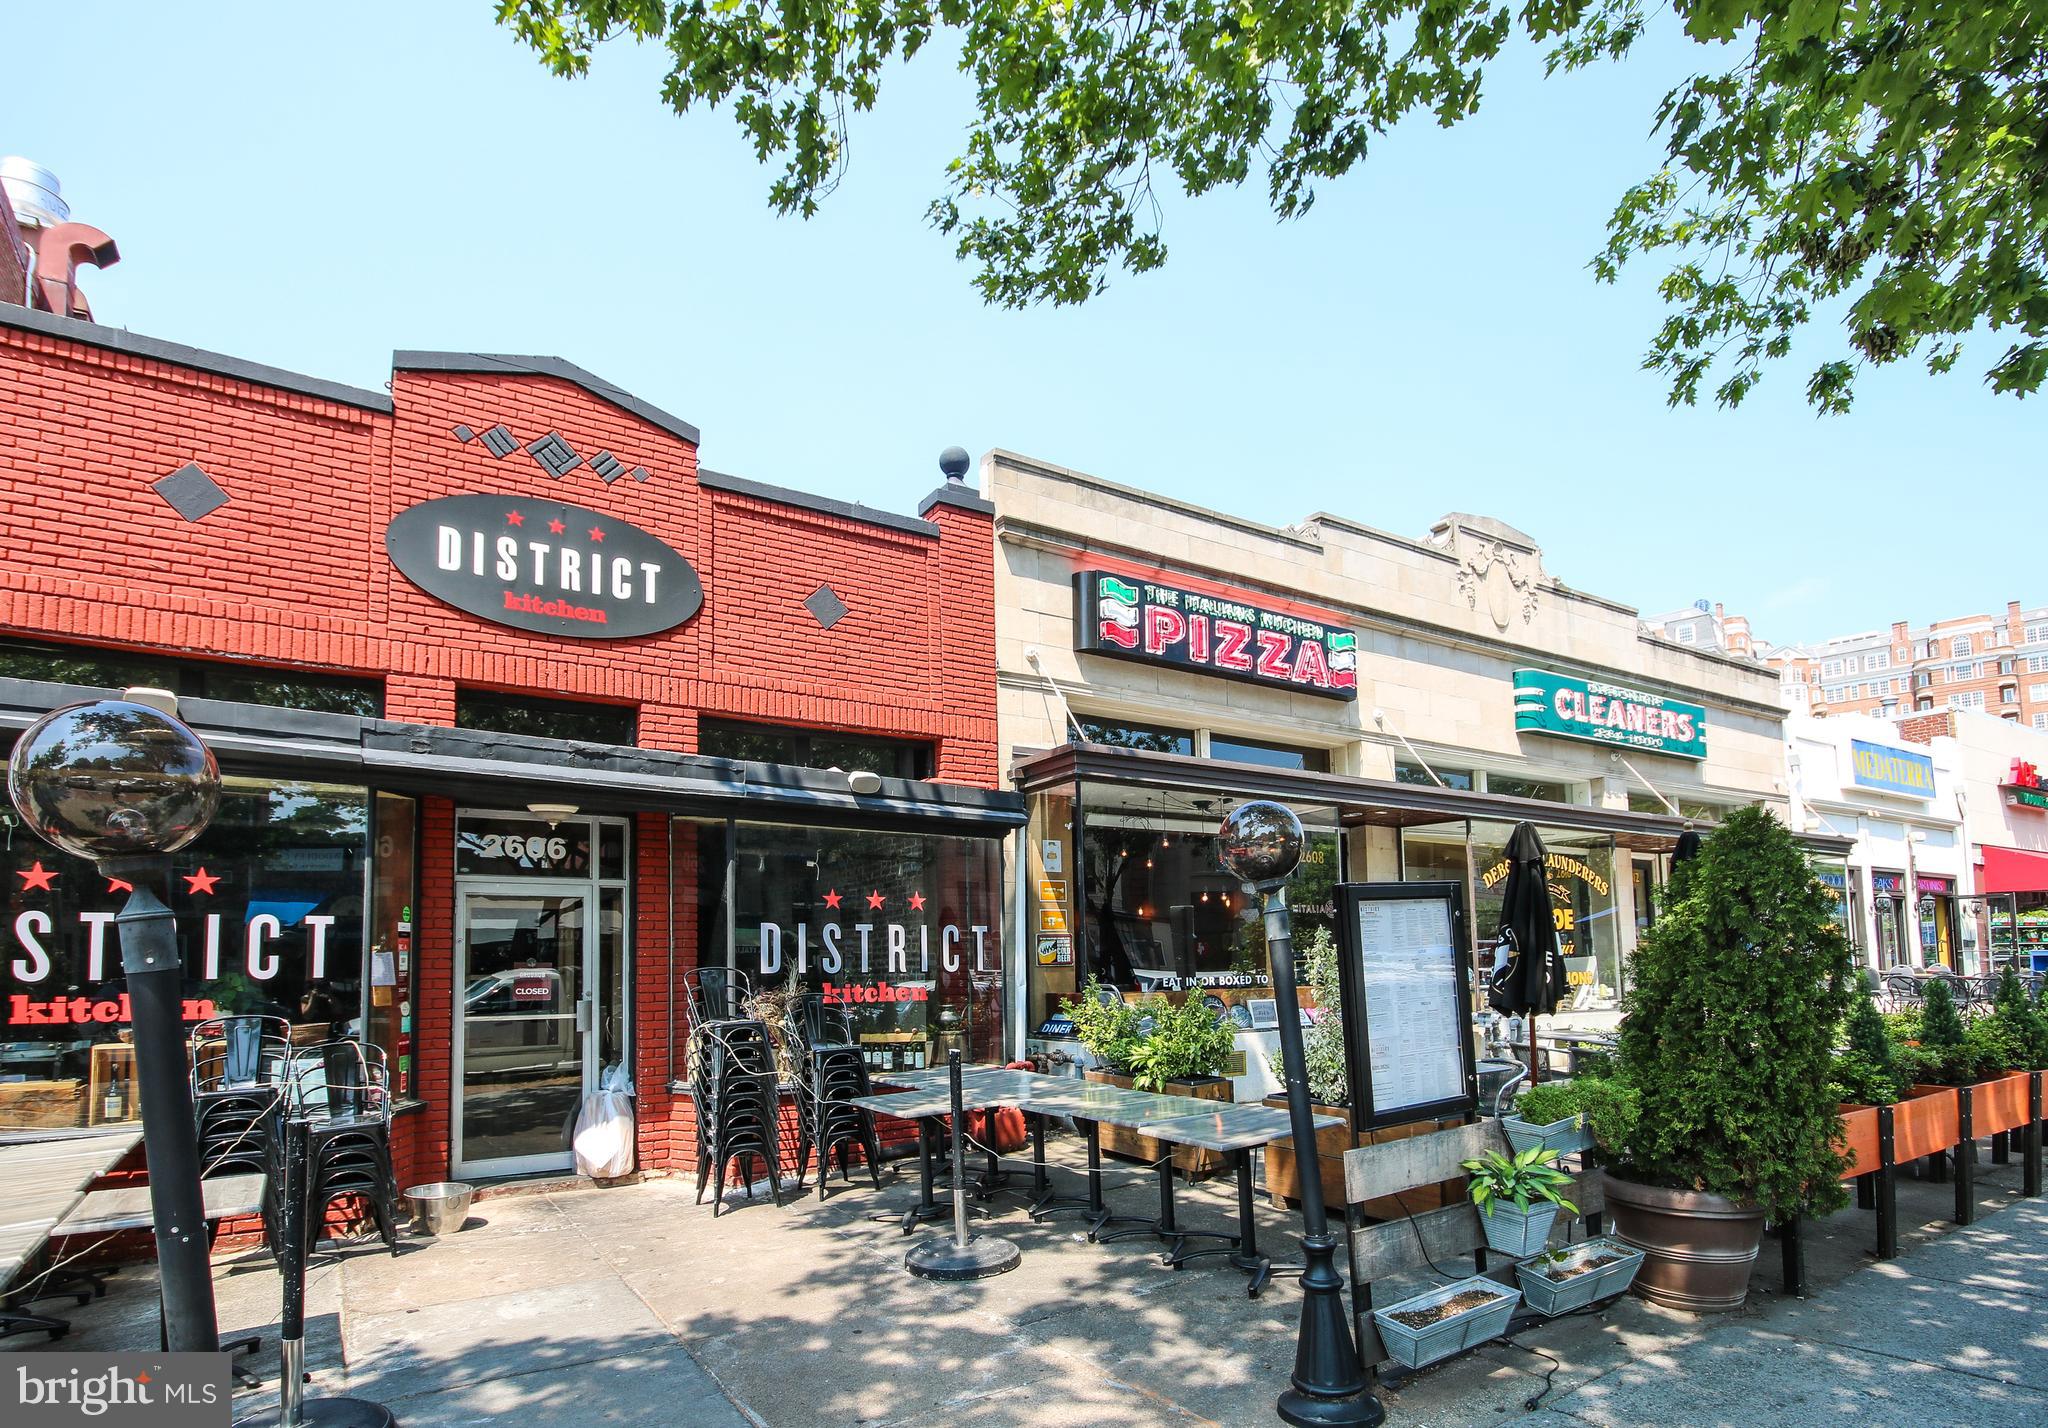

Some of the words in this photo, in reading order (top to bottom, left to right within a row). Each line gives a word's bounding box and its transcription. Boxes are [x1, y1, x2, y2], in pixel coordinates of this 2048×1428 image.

[438, 525, 661, 604] DISTRICT
[503, 591, 608, 624] kitchen
[1144, 585, 1179, 606] THE
[1144, 604, 1330, 688] PIZZA
[1554, 688, 1695, 742] CLEANERS
[11, 910, 336, 982] STICT
[760, 922, 988, 974] DISTRICT
[515, 987, 549, 995] CLOSED
[823, 982, 929, 1004] kitchen
[1163, 977, 1182, 988] EAT
[1186, 976, 1197, 987] IN
[1202, 976, 1215, 986] OR
[1219, 975, 1252, 986] BOXED
[1254, 974, 1268, 985] TO
[1041, 1023, 1073, 1034] DINER
